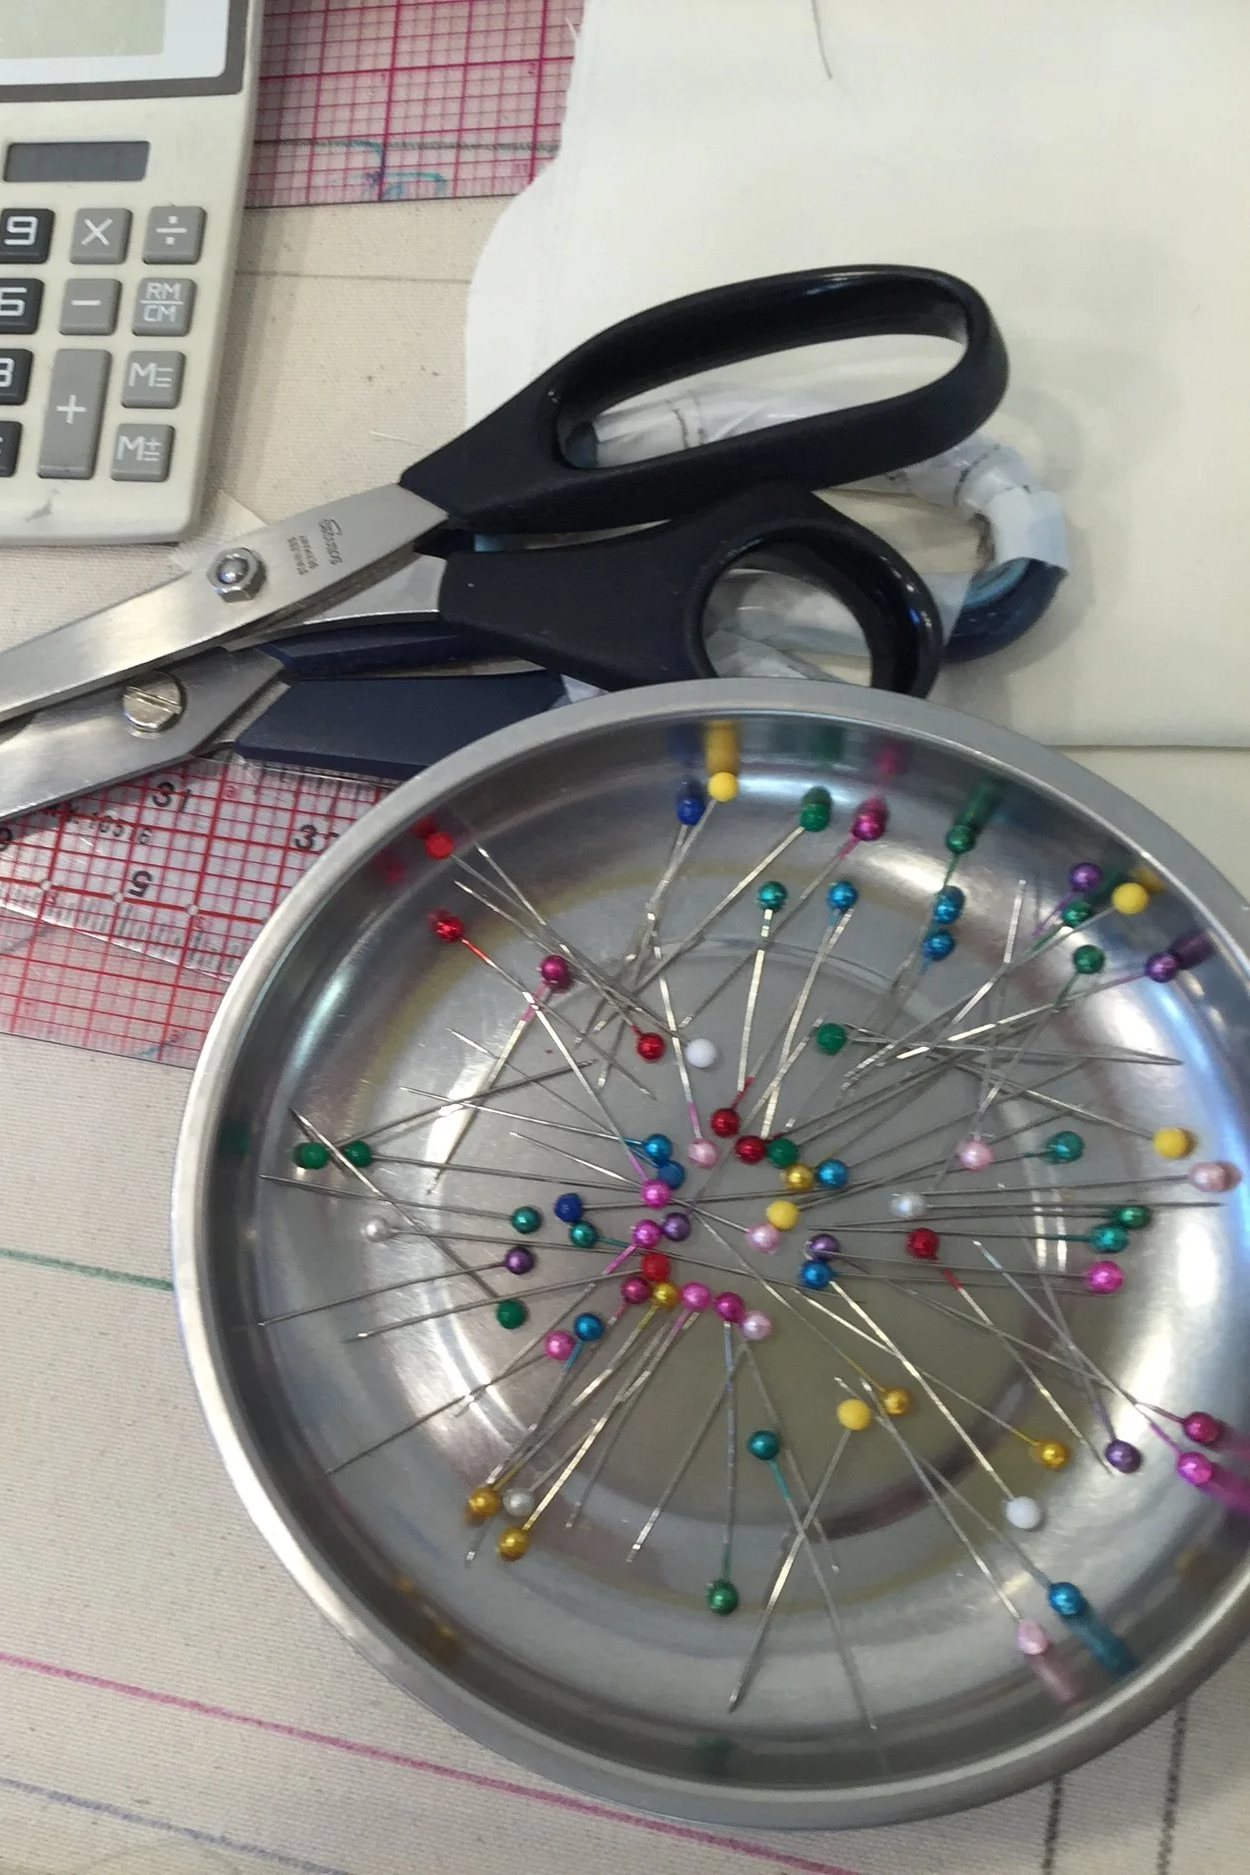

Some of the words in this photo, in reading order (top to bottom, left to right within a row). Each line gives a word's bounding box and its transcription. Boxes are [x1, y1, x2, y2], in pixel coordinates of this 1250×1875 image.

[4, 216, 38, 246] 9
[145, 282, 182, 299] RM
[143, 305, 177, 323] CM
